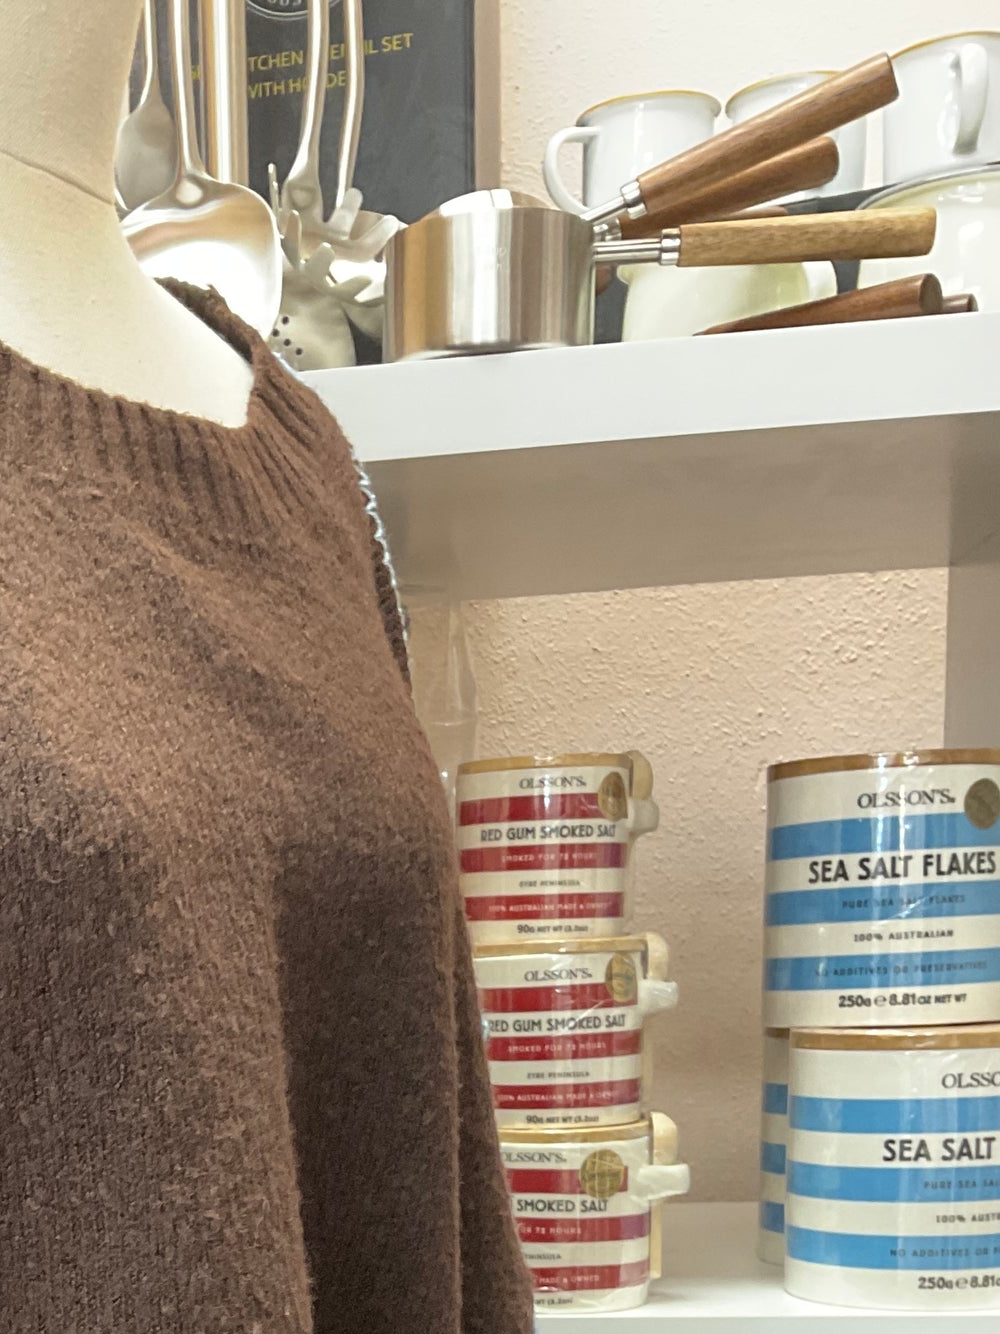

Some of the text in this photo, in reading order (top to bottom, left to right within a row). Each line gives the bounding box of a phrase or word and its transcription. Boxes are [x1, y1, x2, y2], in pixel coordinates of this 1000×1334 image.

[381, 33, 413, 52] SET
[480, 824, 616, 842] RED GUM SMOKED SALT
[808, 851, 996, 884] SEA SALT FLAKES
[508, 903, 555, 912] AUSTRALIAN
[853, 930, 954, 942] 100% AUSTRALIAN
[833, 966, 888, 976] ADDITIVES
[934, 994, 953, 1004] NET
[954, 993, 967, 1003] WT
[490, 1014, 626, 1032] RED GUM SMOKED SALT
[508, 1045, 541, 1053] SMOKED
[544, 1044, 562, 1052] FOR
[517, 1093, 564, 1101] AUSTRALIAN
[882, 1137, 996, 1162] SEA SALT
[923, 1181, 952, 1189] PURE
[958, 1180, 977, 1188] SEA
[516, 1199, 608, 1212] SMOKED SALT
[936, 1215, 966, 1224] 100%
[549, 1226, 582, 1235] HOURS
[890, 1249, 907, 1257] NO
[912, 1248, 970, 1257] ADDITIVES
[975, 1247, 988, 1256] OR
[538, 1276, 561, 1284] MADE
[918, 1276, 953, 1290] 250g
